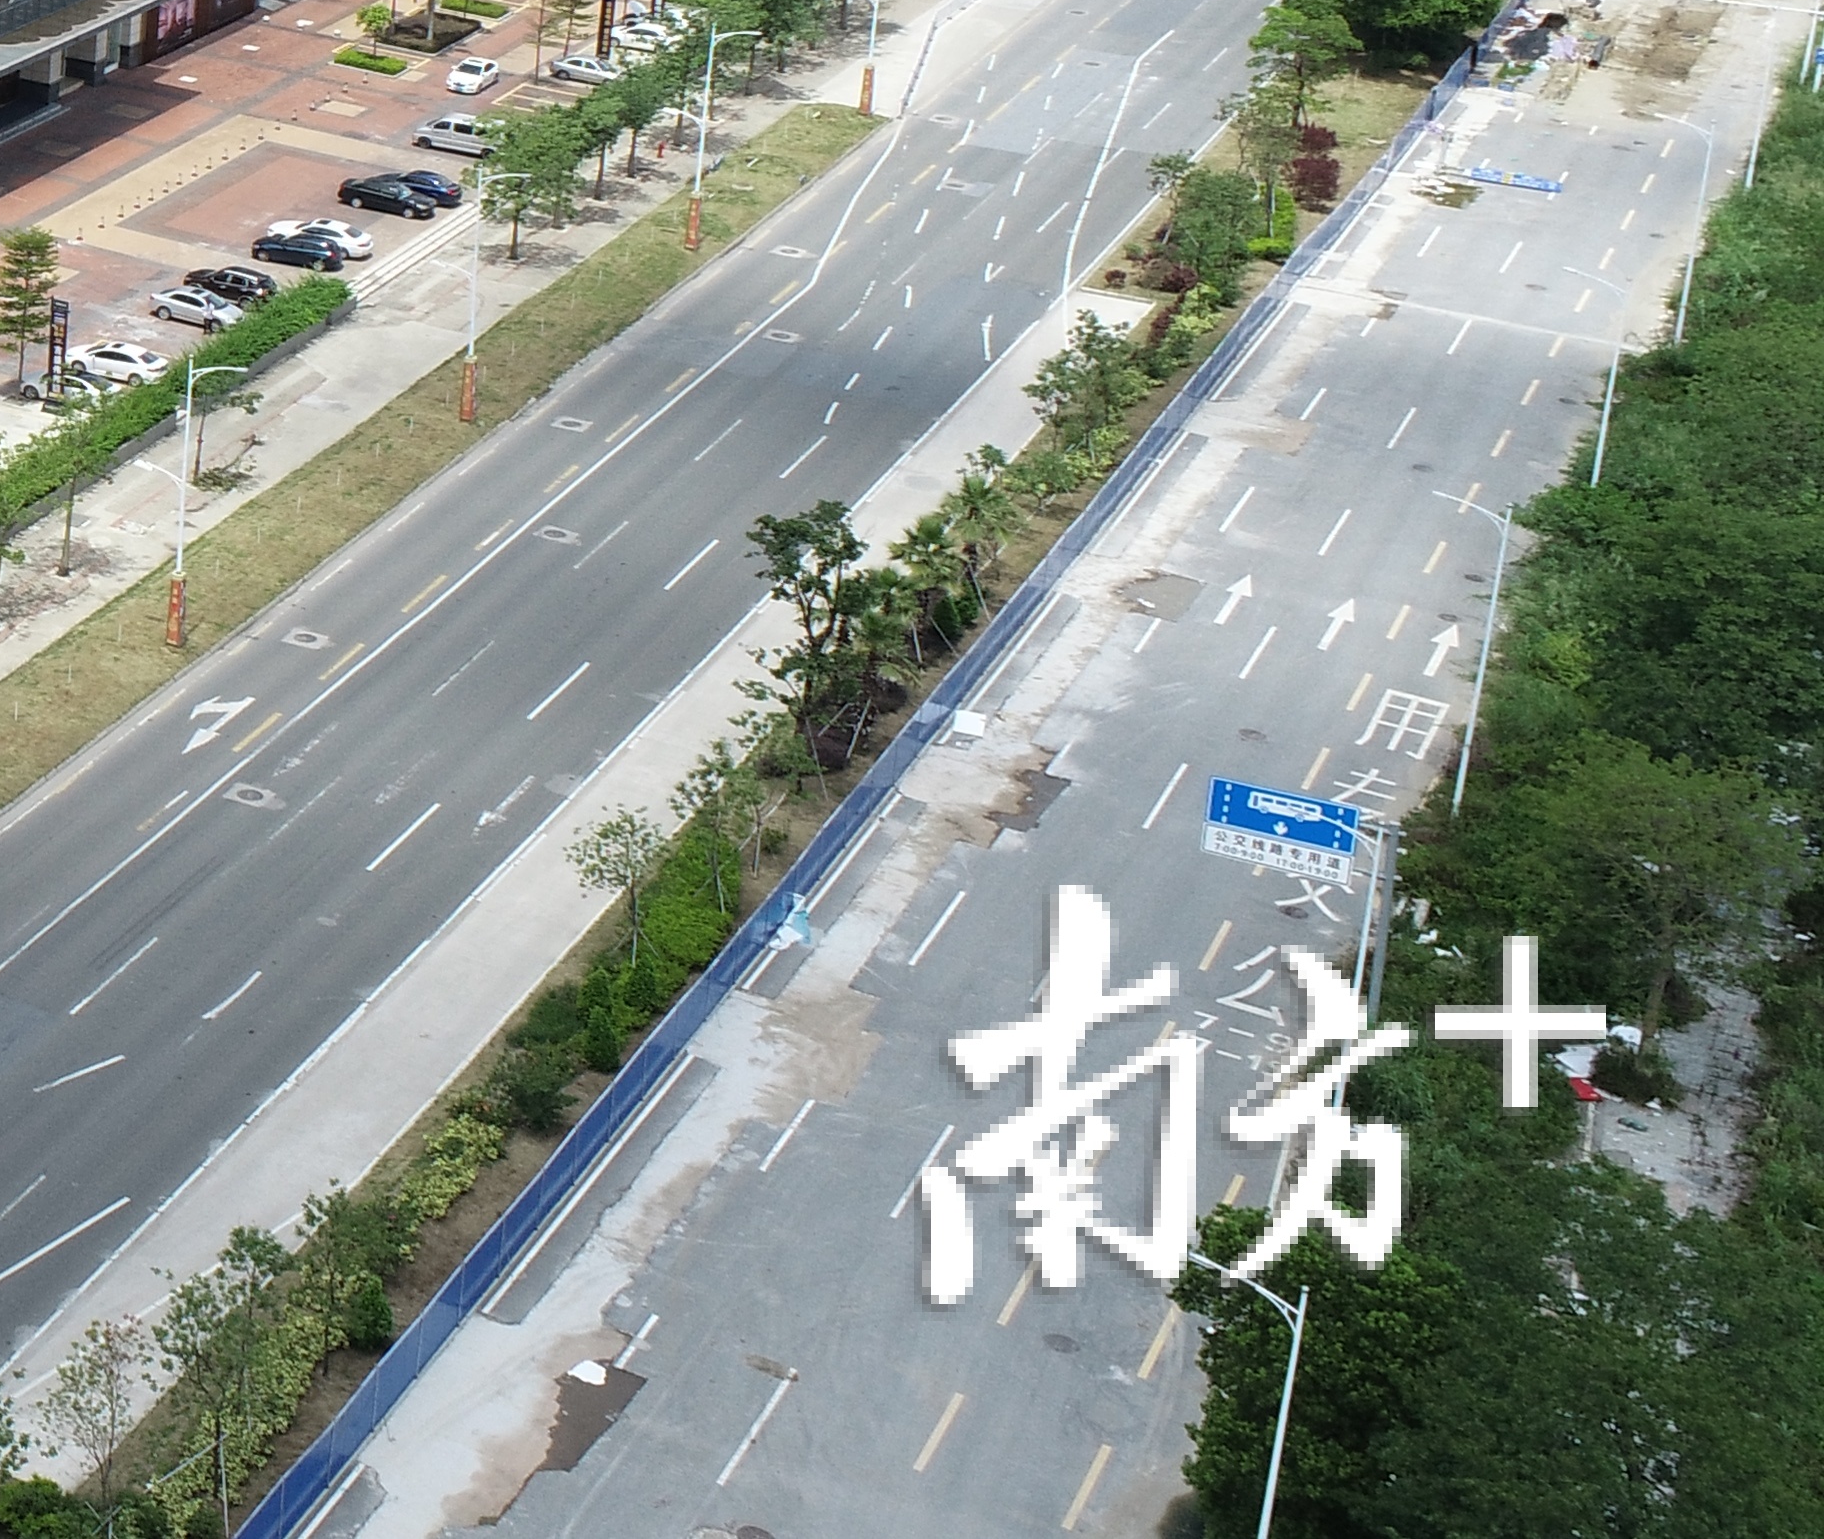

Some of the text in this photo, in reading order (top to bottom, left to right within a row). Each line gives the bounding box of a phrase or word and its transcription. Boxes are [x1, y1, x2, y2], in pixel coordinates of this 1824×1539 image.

[1214, 830, 1341, 870] 公交线路专用道
